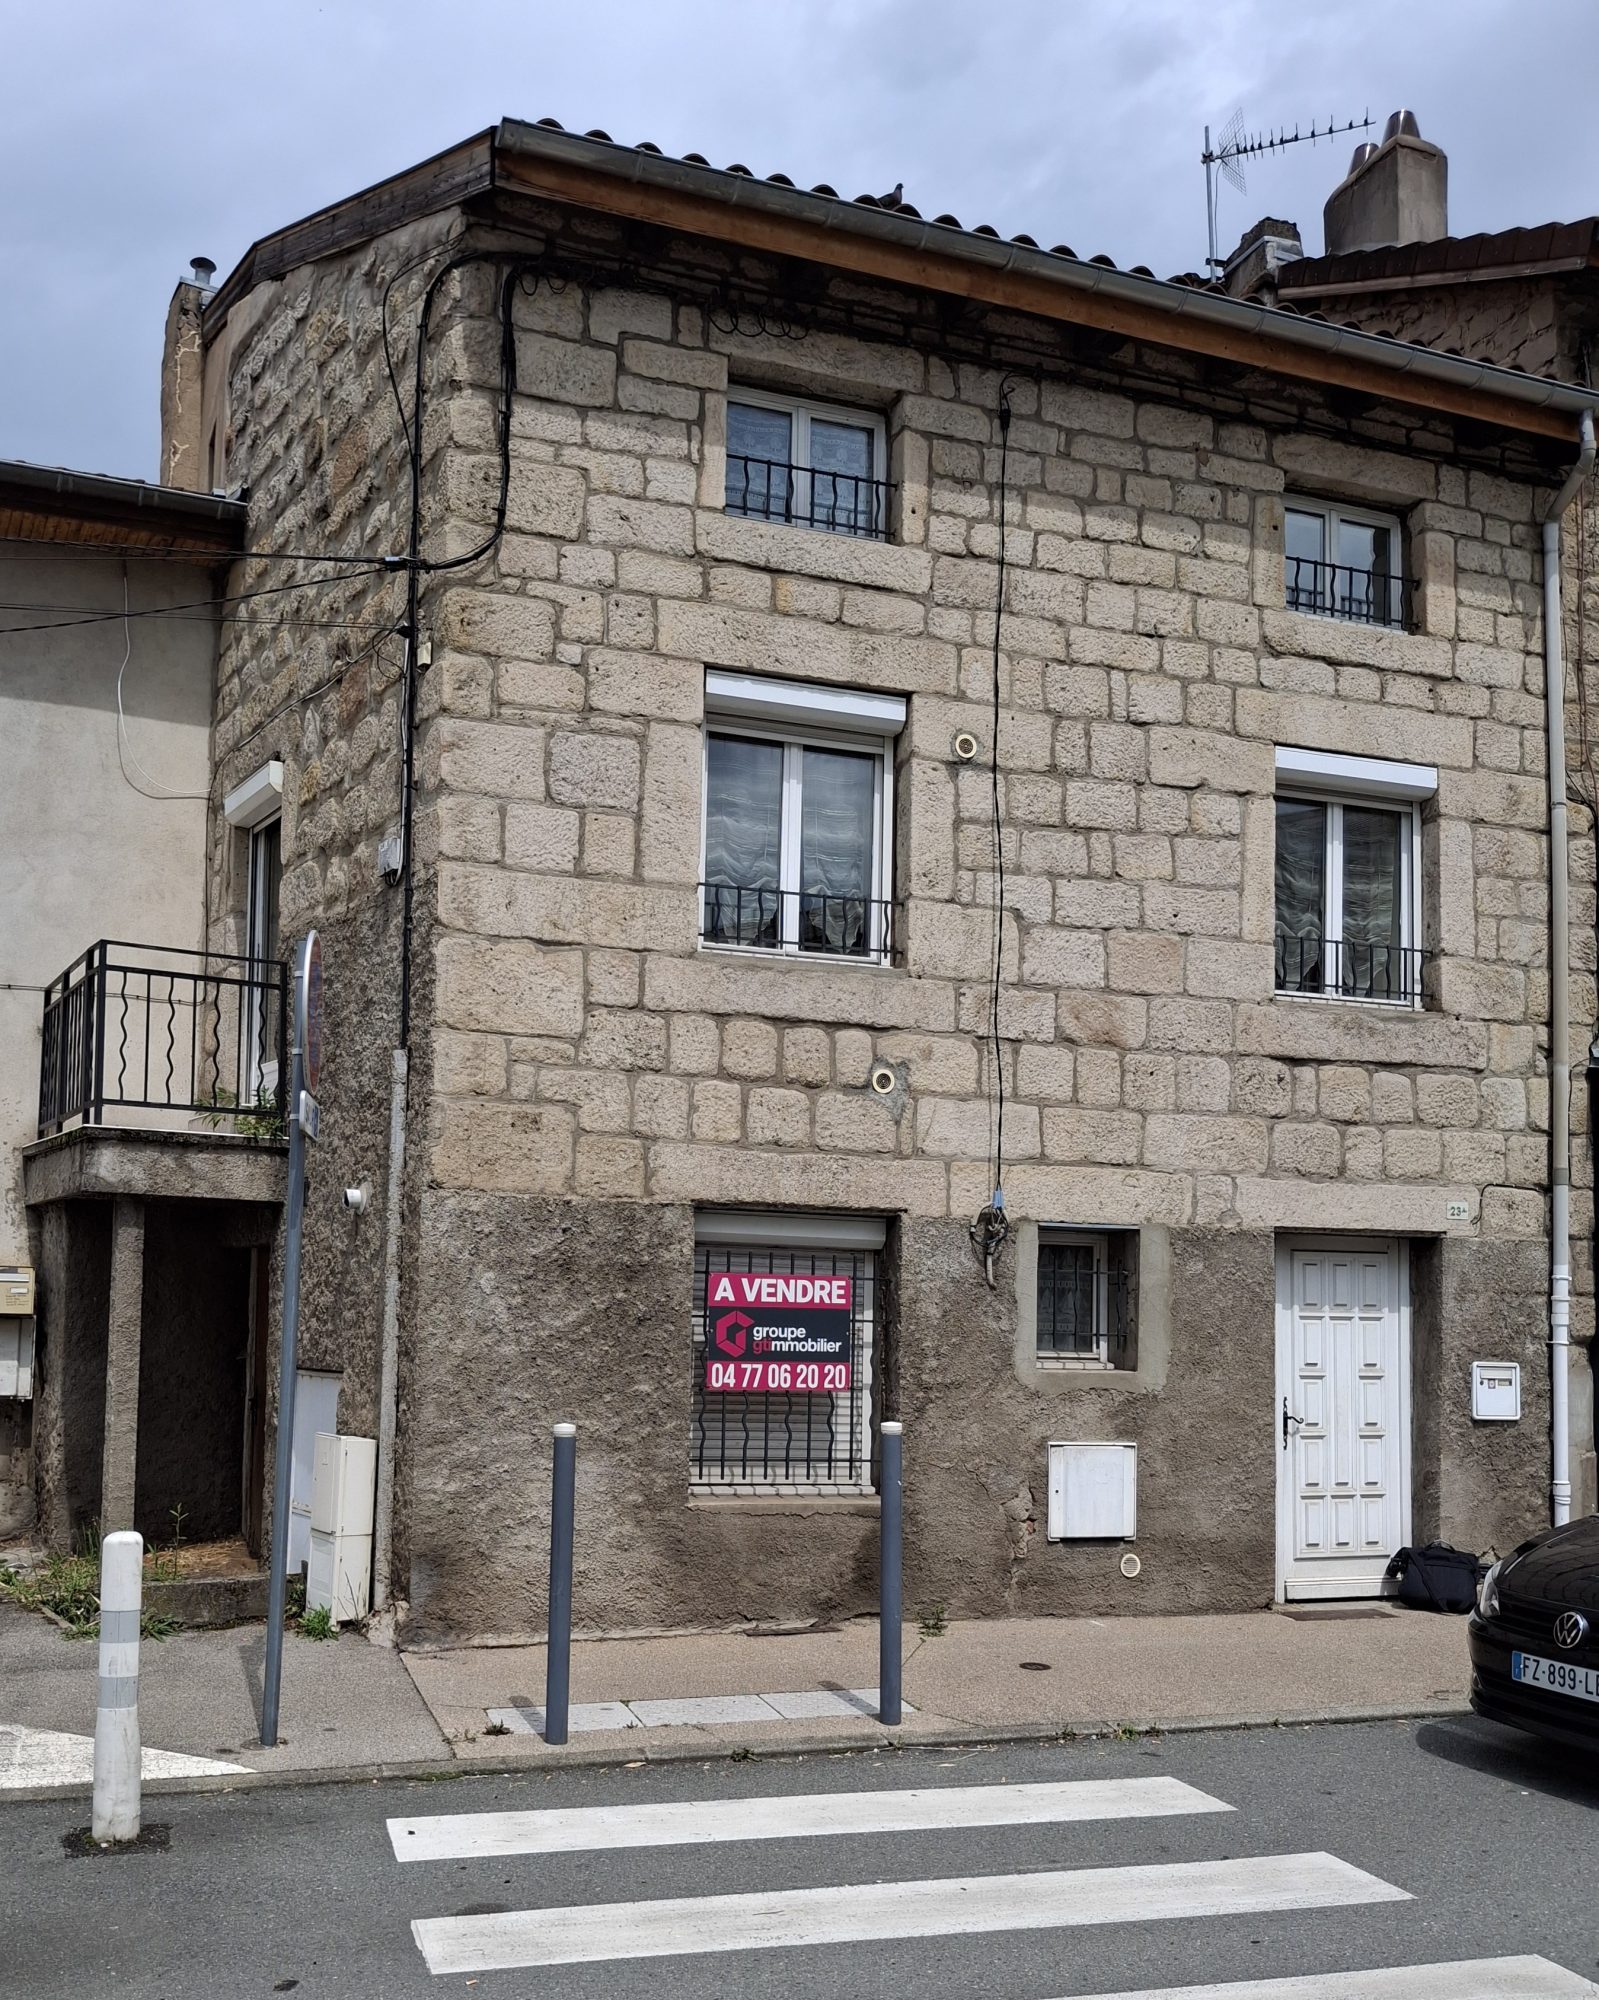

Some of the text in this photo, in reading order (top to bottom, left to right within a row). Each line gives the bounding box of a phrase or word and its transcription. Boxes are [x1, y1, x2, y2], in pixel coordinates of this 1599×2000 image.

[714, 1277, 846, 1304] A VENDRE
[753, 1326, 806, 1341] groupe
[711, 1363, 846, 1389] 04 77 06 20 20
